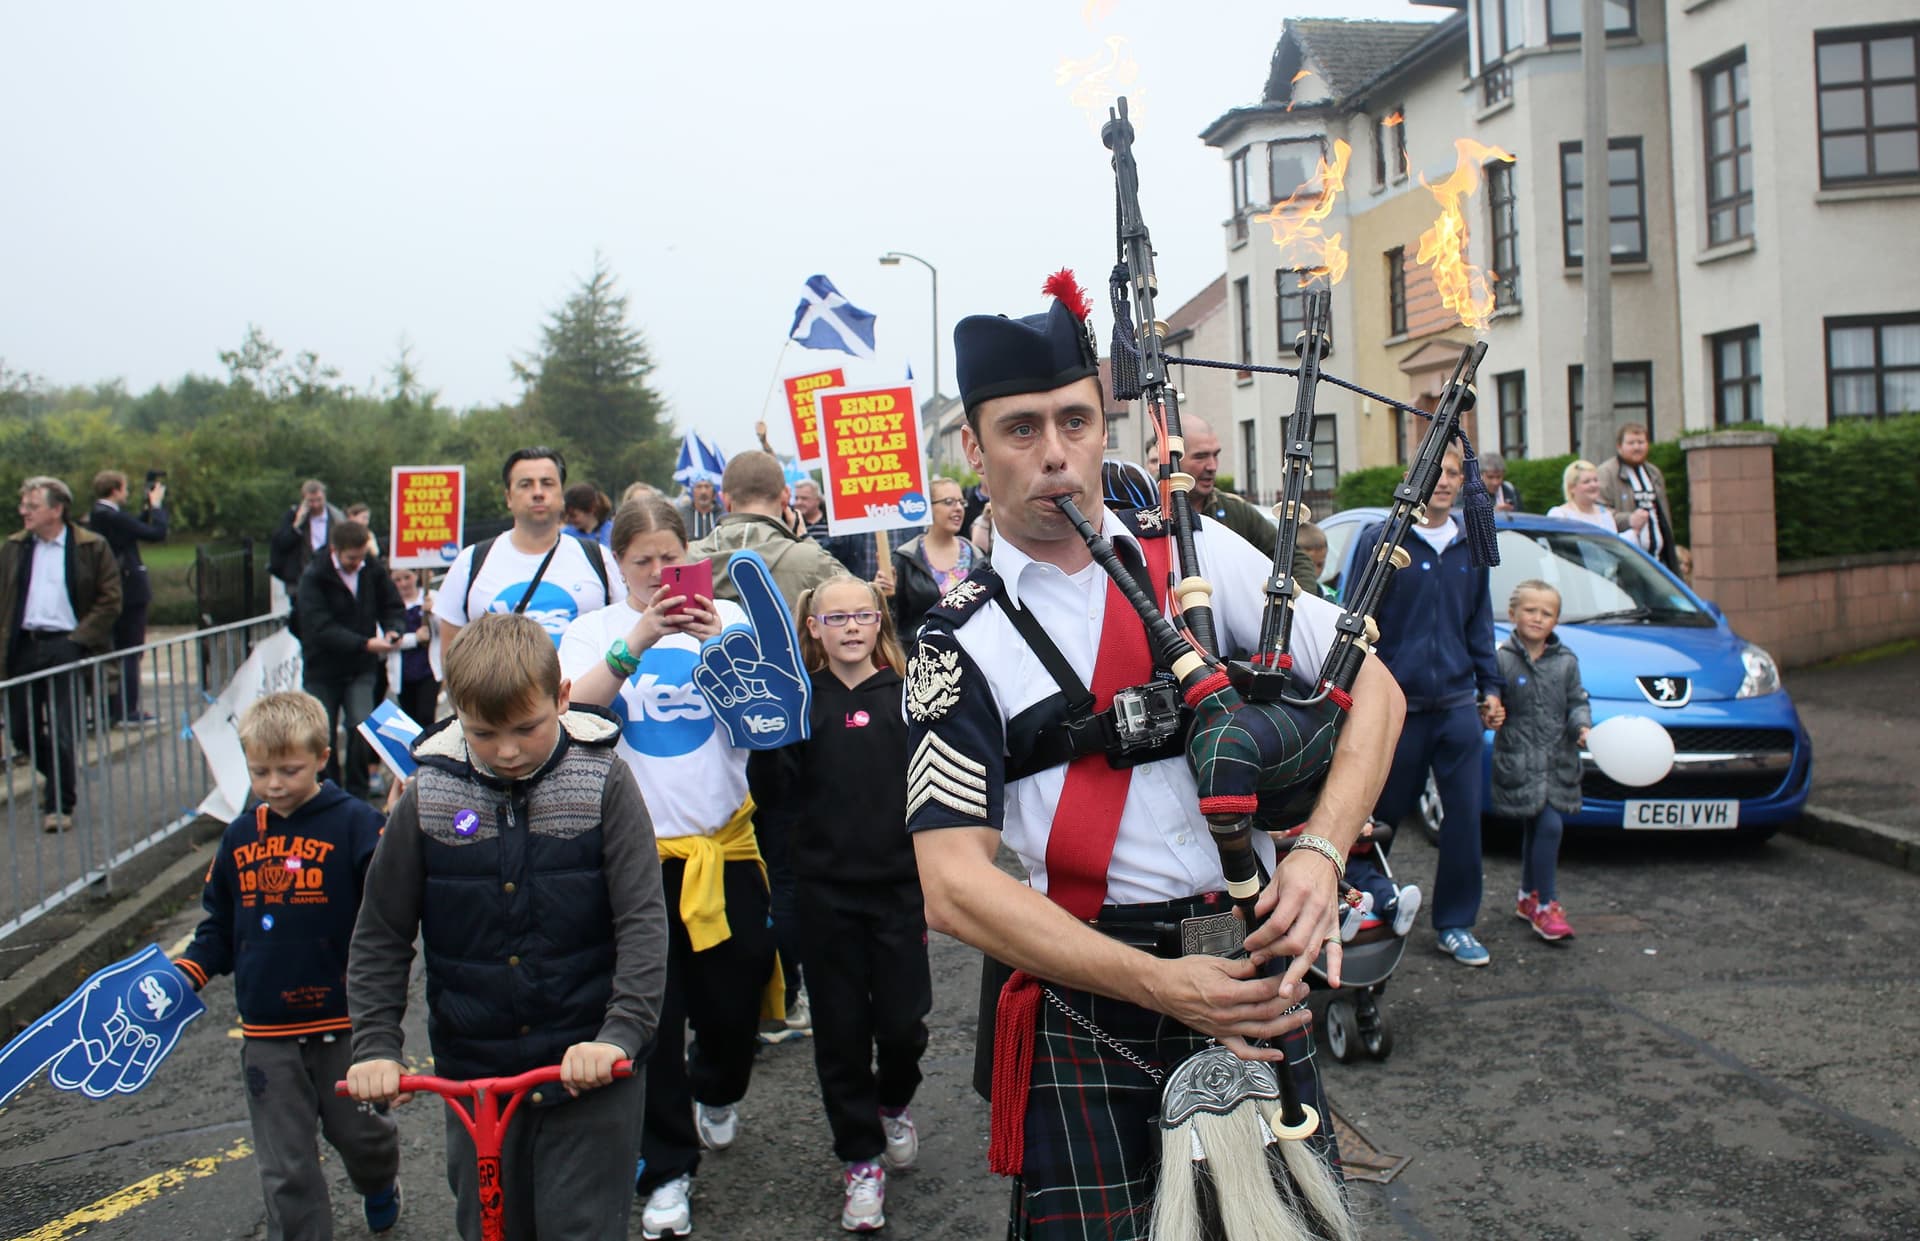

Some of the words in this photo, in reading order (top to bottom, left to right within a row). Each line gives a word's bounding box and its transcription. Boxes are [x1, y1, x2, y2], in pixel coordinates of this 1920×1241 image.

[795, 374, 833, 392] END
[793, 391, 815, 406] TO
[839, 394, 895, 416] END
[834, 413, 904, 436] TORY
[836, 432, 908, 456] RULE
[847, 453, 901, 475] FOR
[410, 474, 448, 488] END
[840, 472, 913, 496] EVER
[404, 487, 453, 501] TORY
[403, 501, 453, 515] RULE
[863, 502, 898, 519] Vote
[898, 499, 926, 514] Yes
[409, 515, 446, 528] FOR
[402, 528, 452, 542] EVER
[618, 673, 713, 722] Yes
[743, 713, 786, 734] Yes
[1638, 803, 1685, 825] CE61
[1691, 803, 1728, 825] VVH
[233, 835, 335, 869] EVERLAST
[239, 870, 257, 892] 19
[294, 867, 323, 889] 10
[138, 975, 173, 1021] Yes
